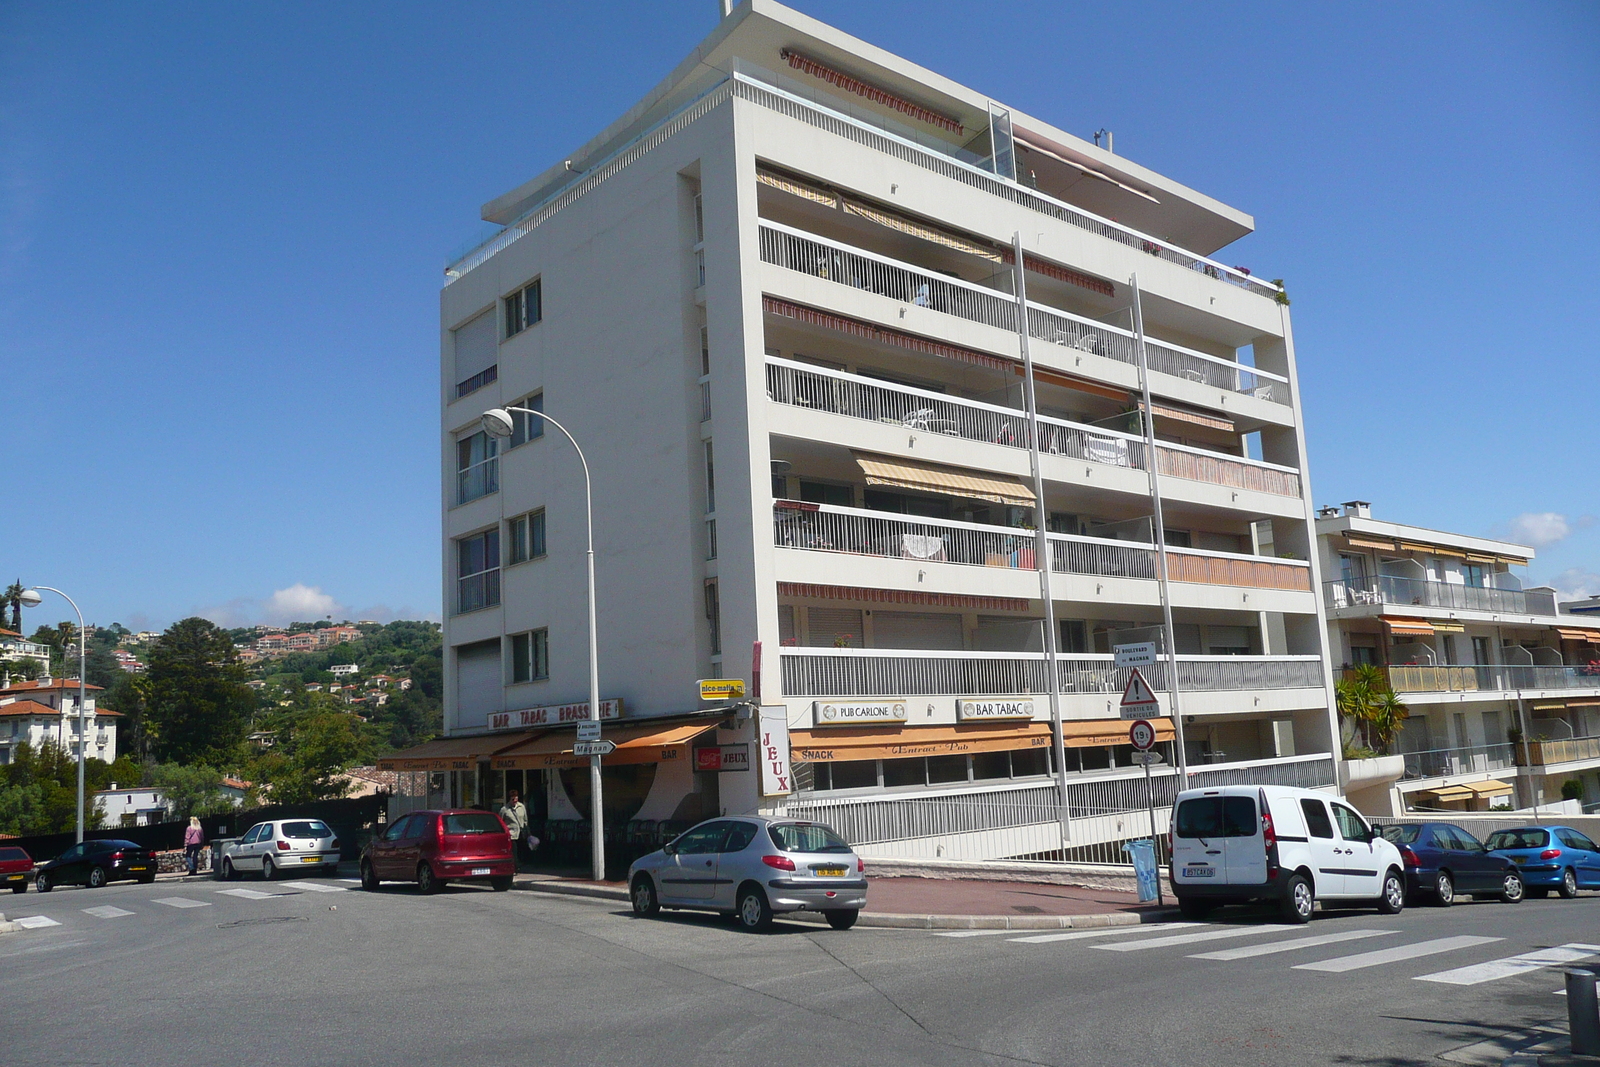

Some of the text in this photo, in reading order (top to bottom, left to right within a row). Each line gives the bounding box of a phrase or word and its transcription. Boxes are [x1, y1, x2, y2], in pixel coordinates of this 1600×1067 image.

[840, 707, 889, 717] PUB CARLONE
[976, 703, 1023, 715] BAR TABAC
[493, 703, 611, 728] BAR TABAC BRASSIE
[1135, 732, 1145, 740] 19
[577, 745, 607, 753] Magnan
[801, 750, 834, 759] SNACK
[945, 742, 968, 751] Pub
[1031, 738, 1045, 746] BAR
[496, 760, 516, 768] SNACK
[662, 750, 677, 759] BAR
[723, 753, 747, 763] JEUX
[763, 733, 788, 791] JEUX
